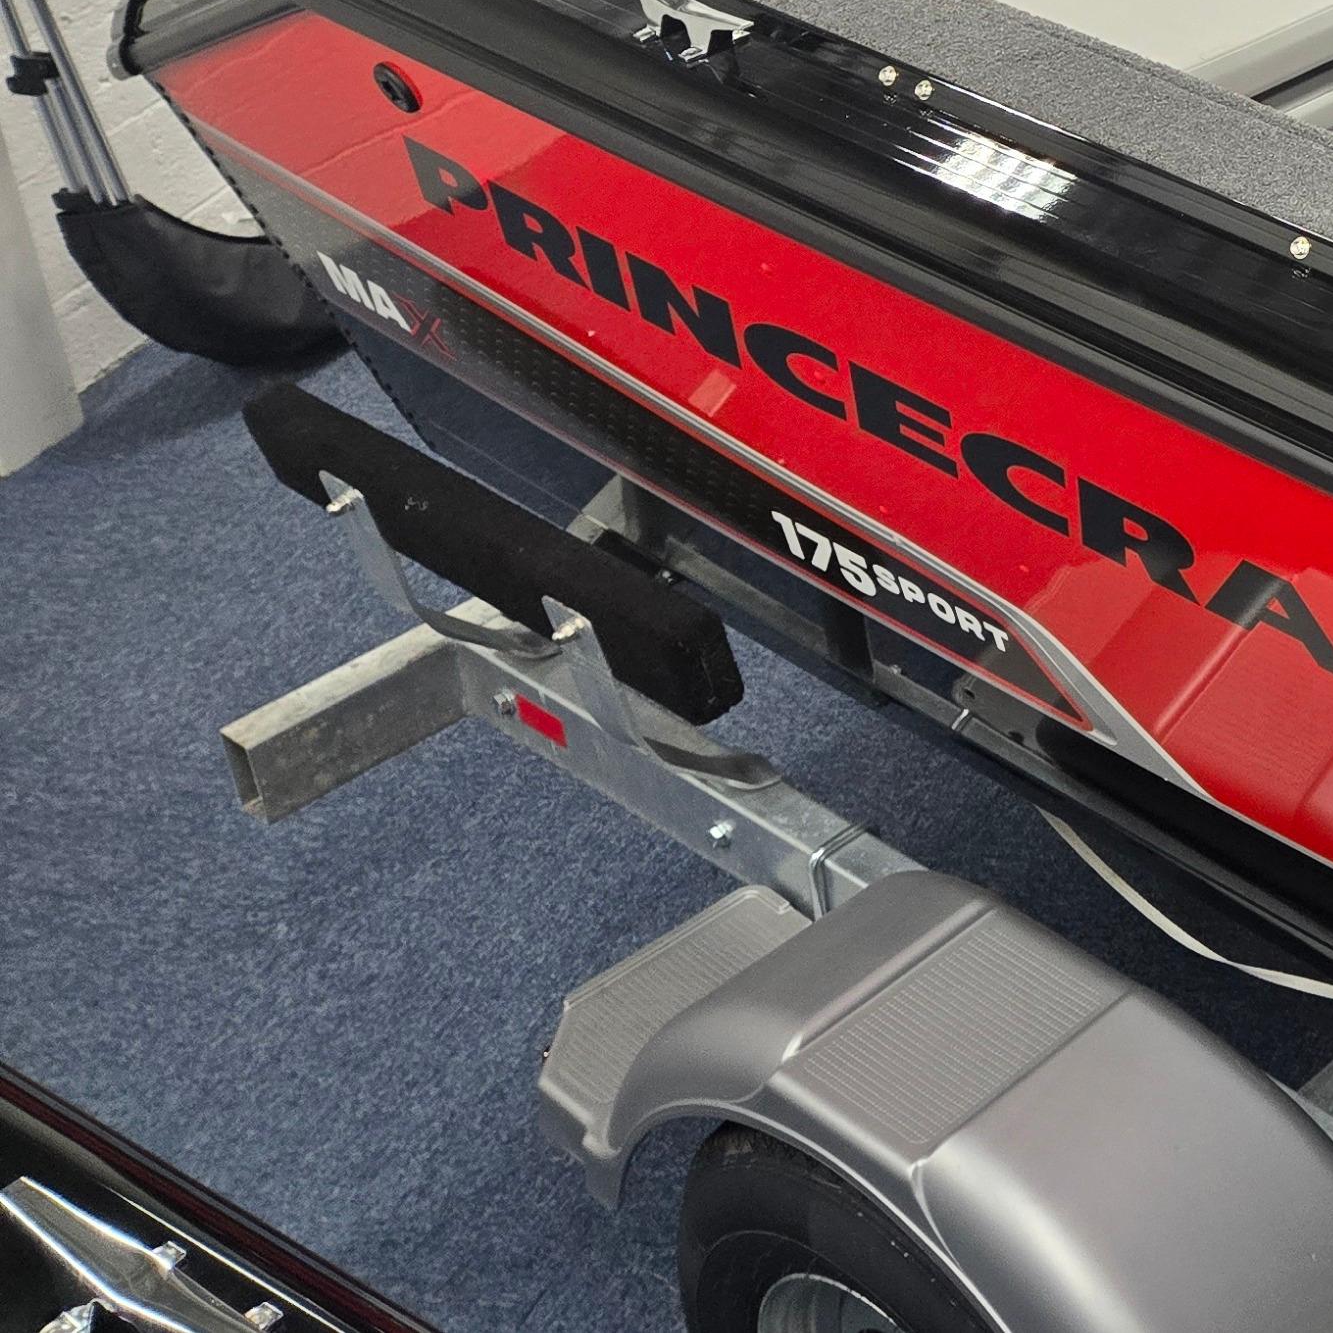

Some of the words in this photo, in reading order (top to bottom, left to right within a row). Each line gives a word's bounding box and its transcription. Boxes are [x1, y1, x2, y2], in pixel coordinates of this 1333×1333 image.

[315, 249, 458, 363] MAX
[770, 509, 879, 598] 175
[871, 562, 1010, 654] SPORT
